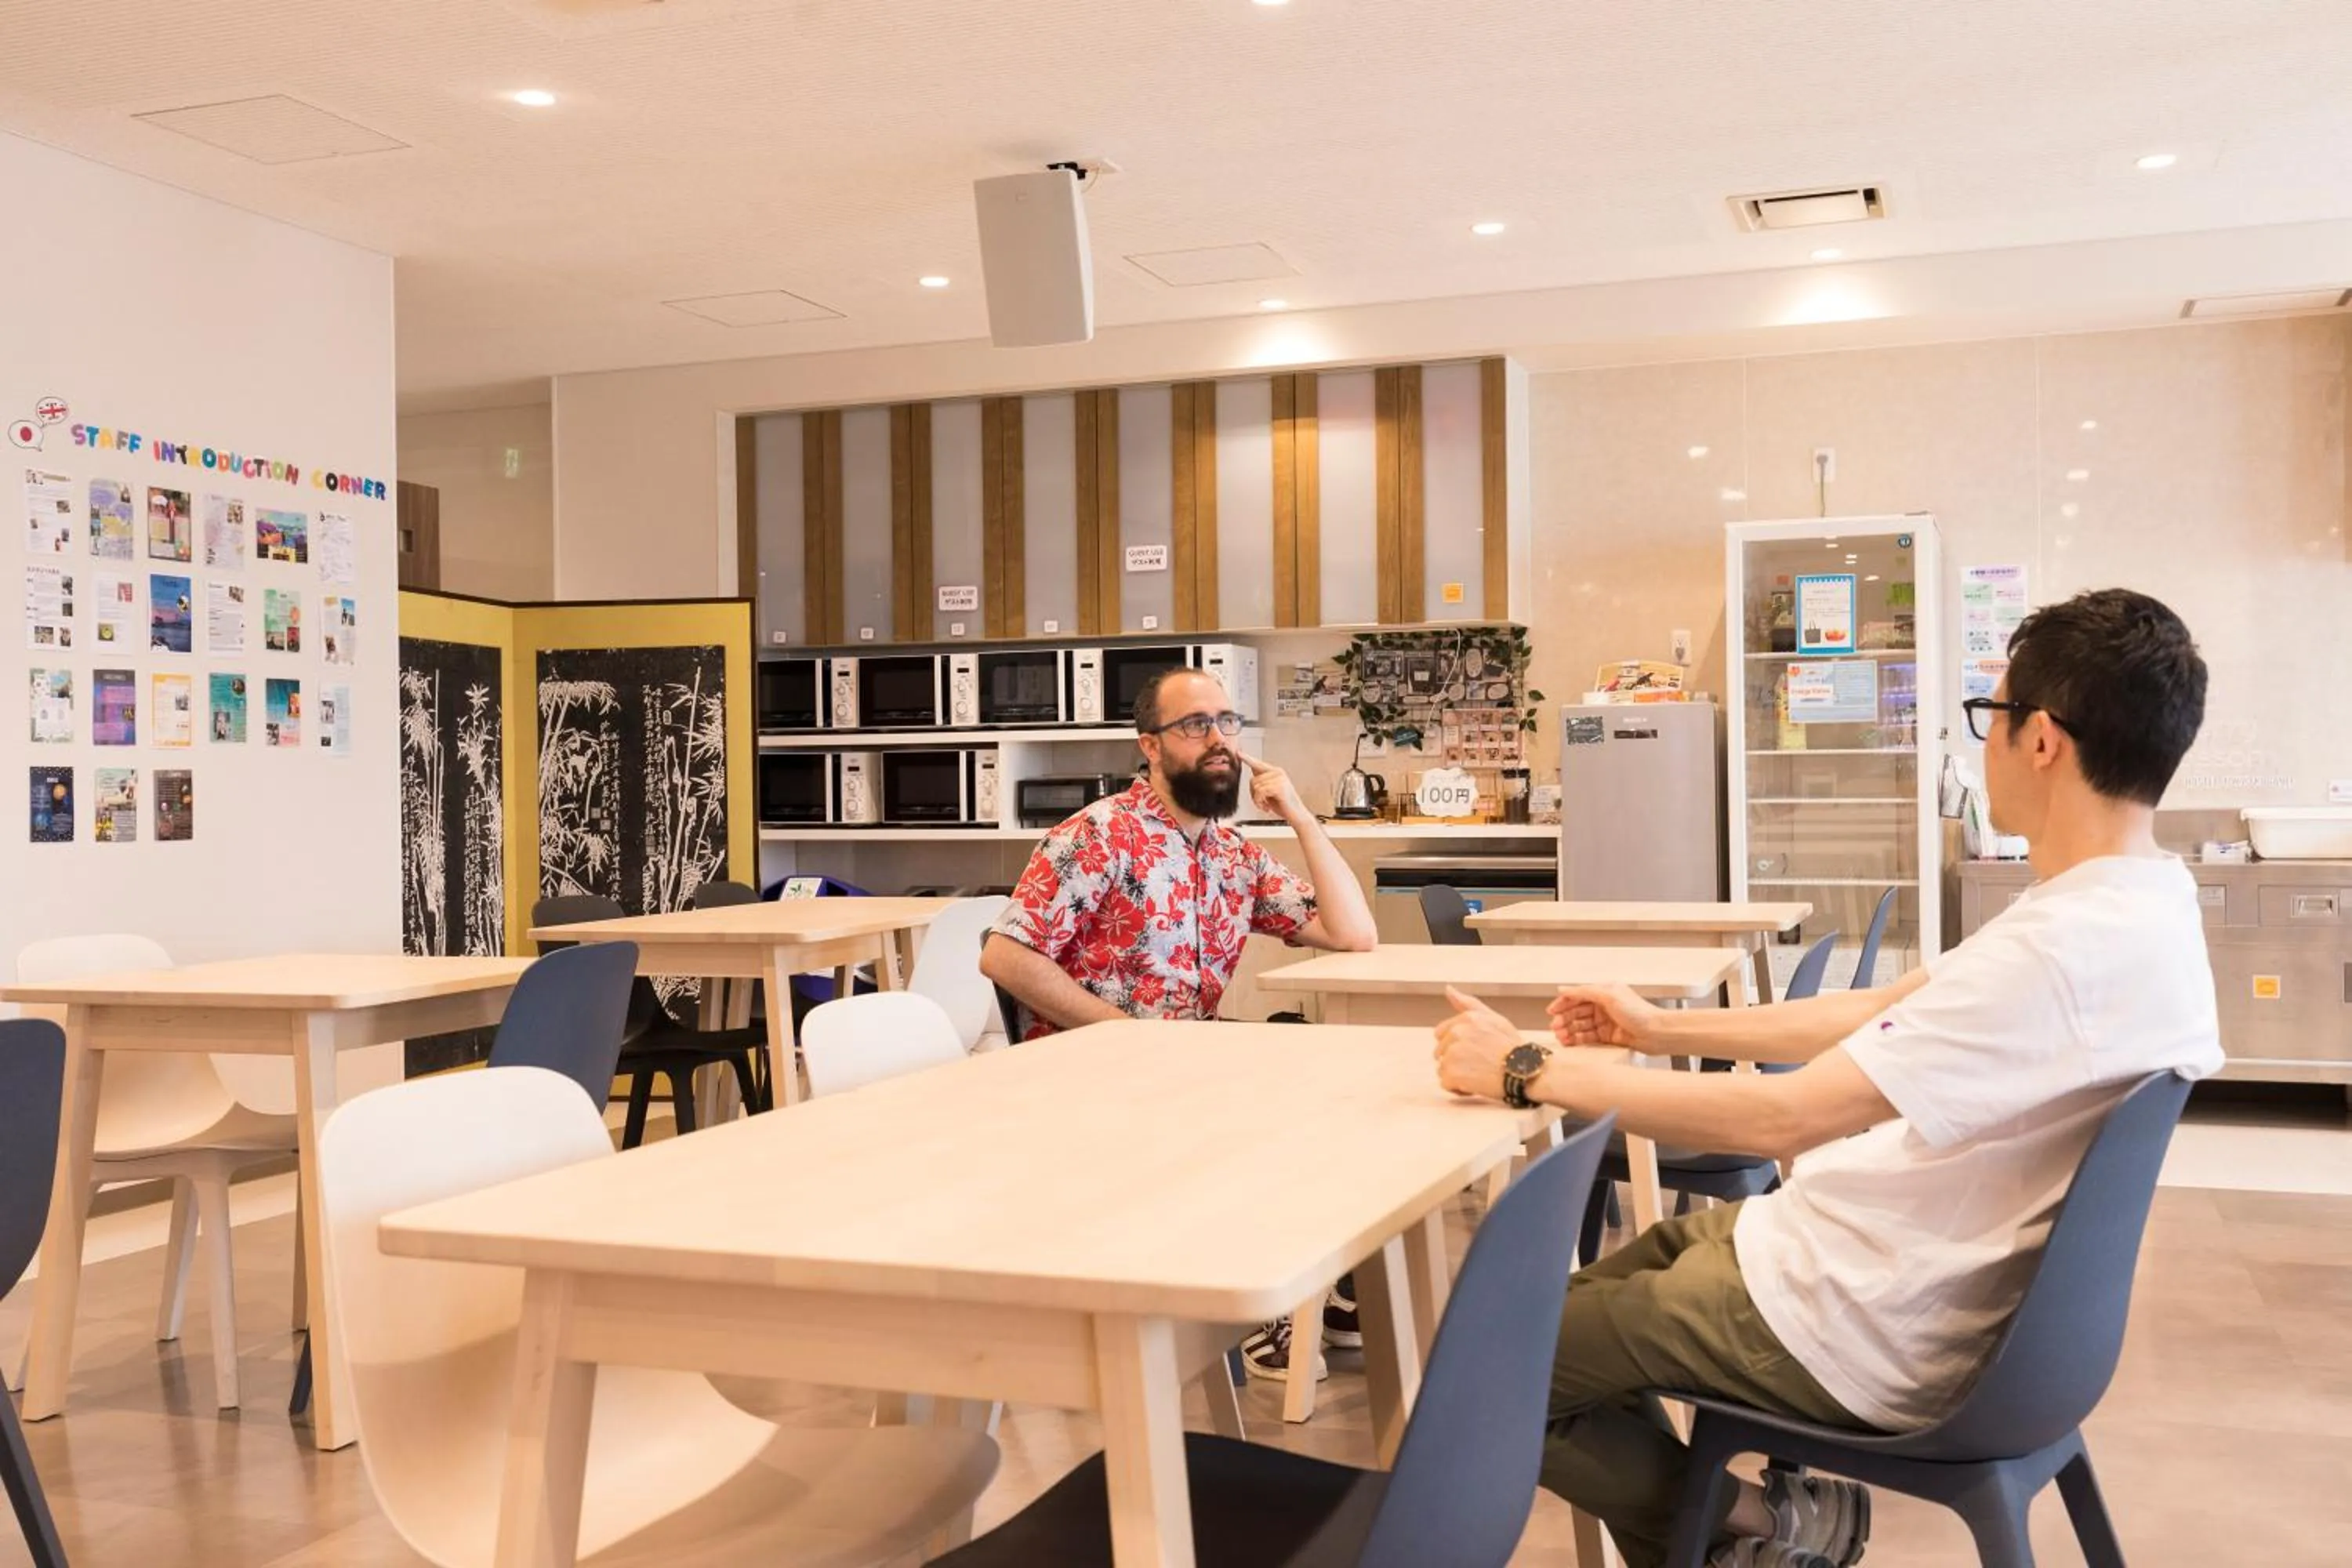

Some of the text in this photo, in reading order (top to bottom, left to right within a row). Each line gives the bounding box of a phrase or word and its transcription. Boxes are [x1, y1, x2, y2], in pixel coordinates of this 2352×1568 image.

[71, 424, 387, 501] STAFF INTRODUCTION CORNER
[1421, 787, 1470, 804] 100円
